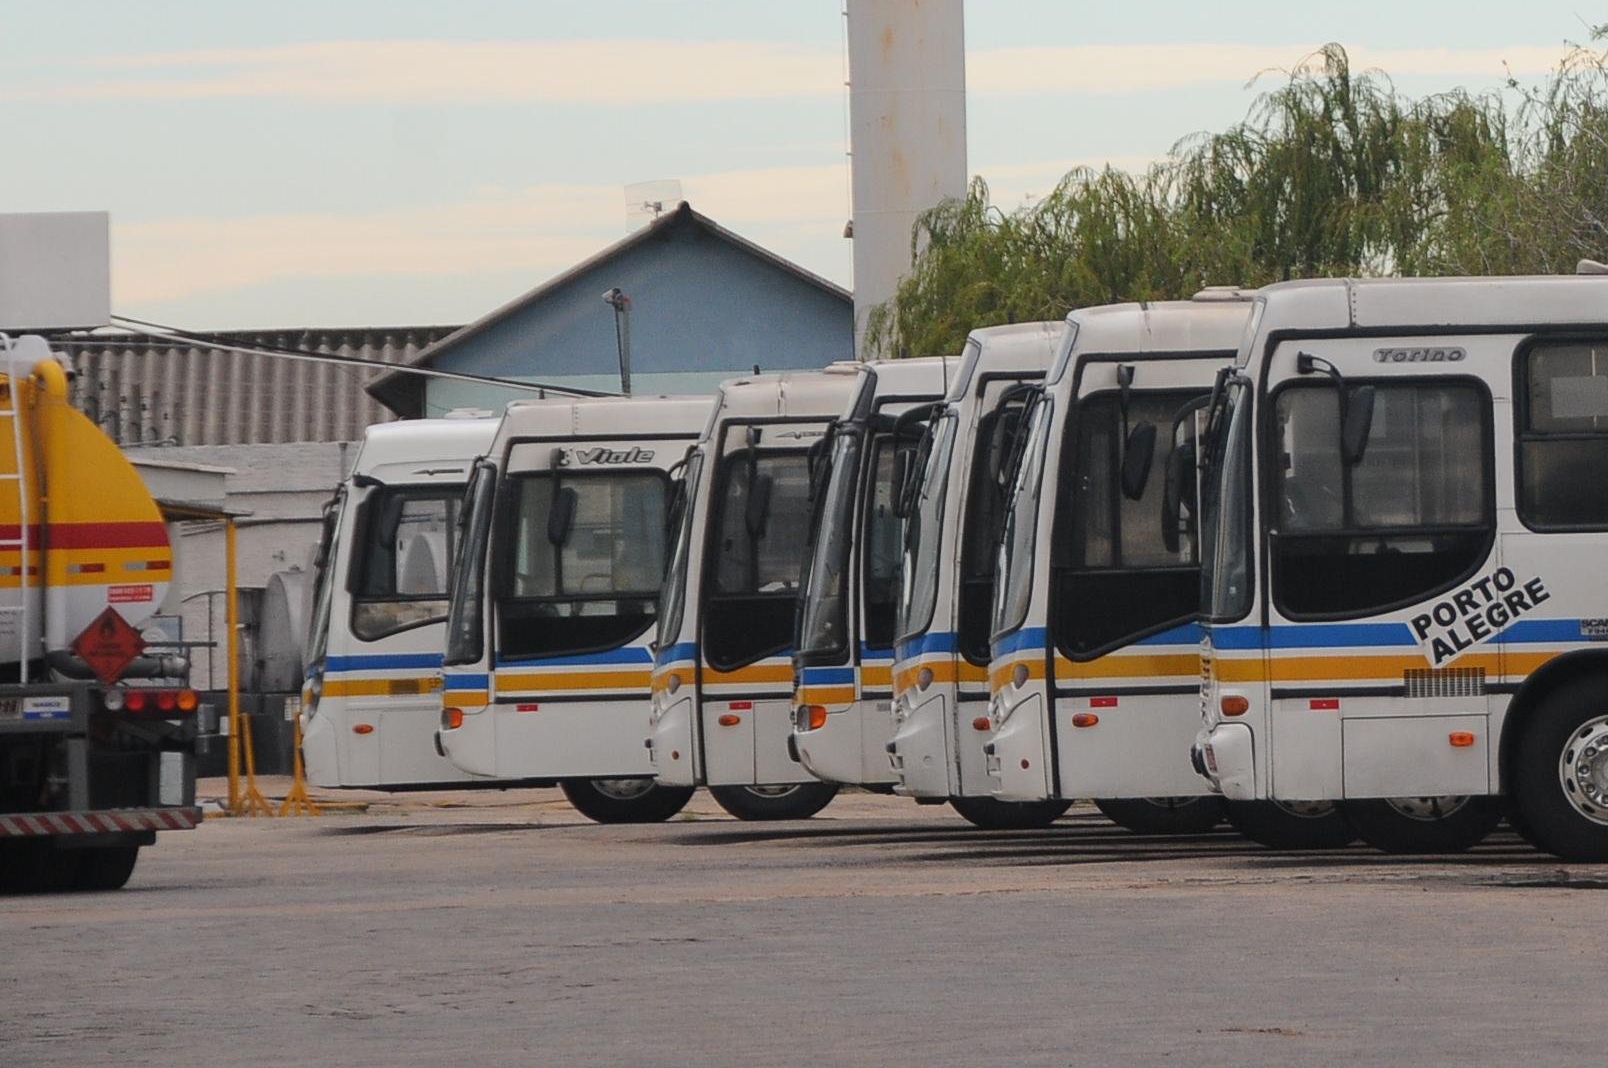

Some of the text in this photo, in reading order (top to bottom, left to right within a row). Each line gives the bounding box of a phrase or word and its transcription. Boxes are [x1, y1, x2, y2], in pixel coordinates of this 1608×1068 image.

[1378, 348, 1464, 363] Torino
[576, 446, 655, 465] Viale
[1411, 567, 1515, 641] PORTO
[1431, 577, 1551, 665] ALEGRE
